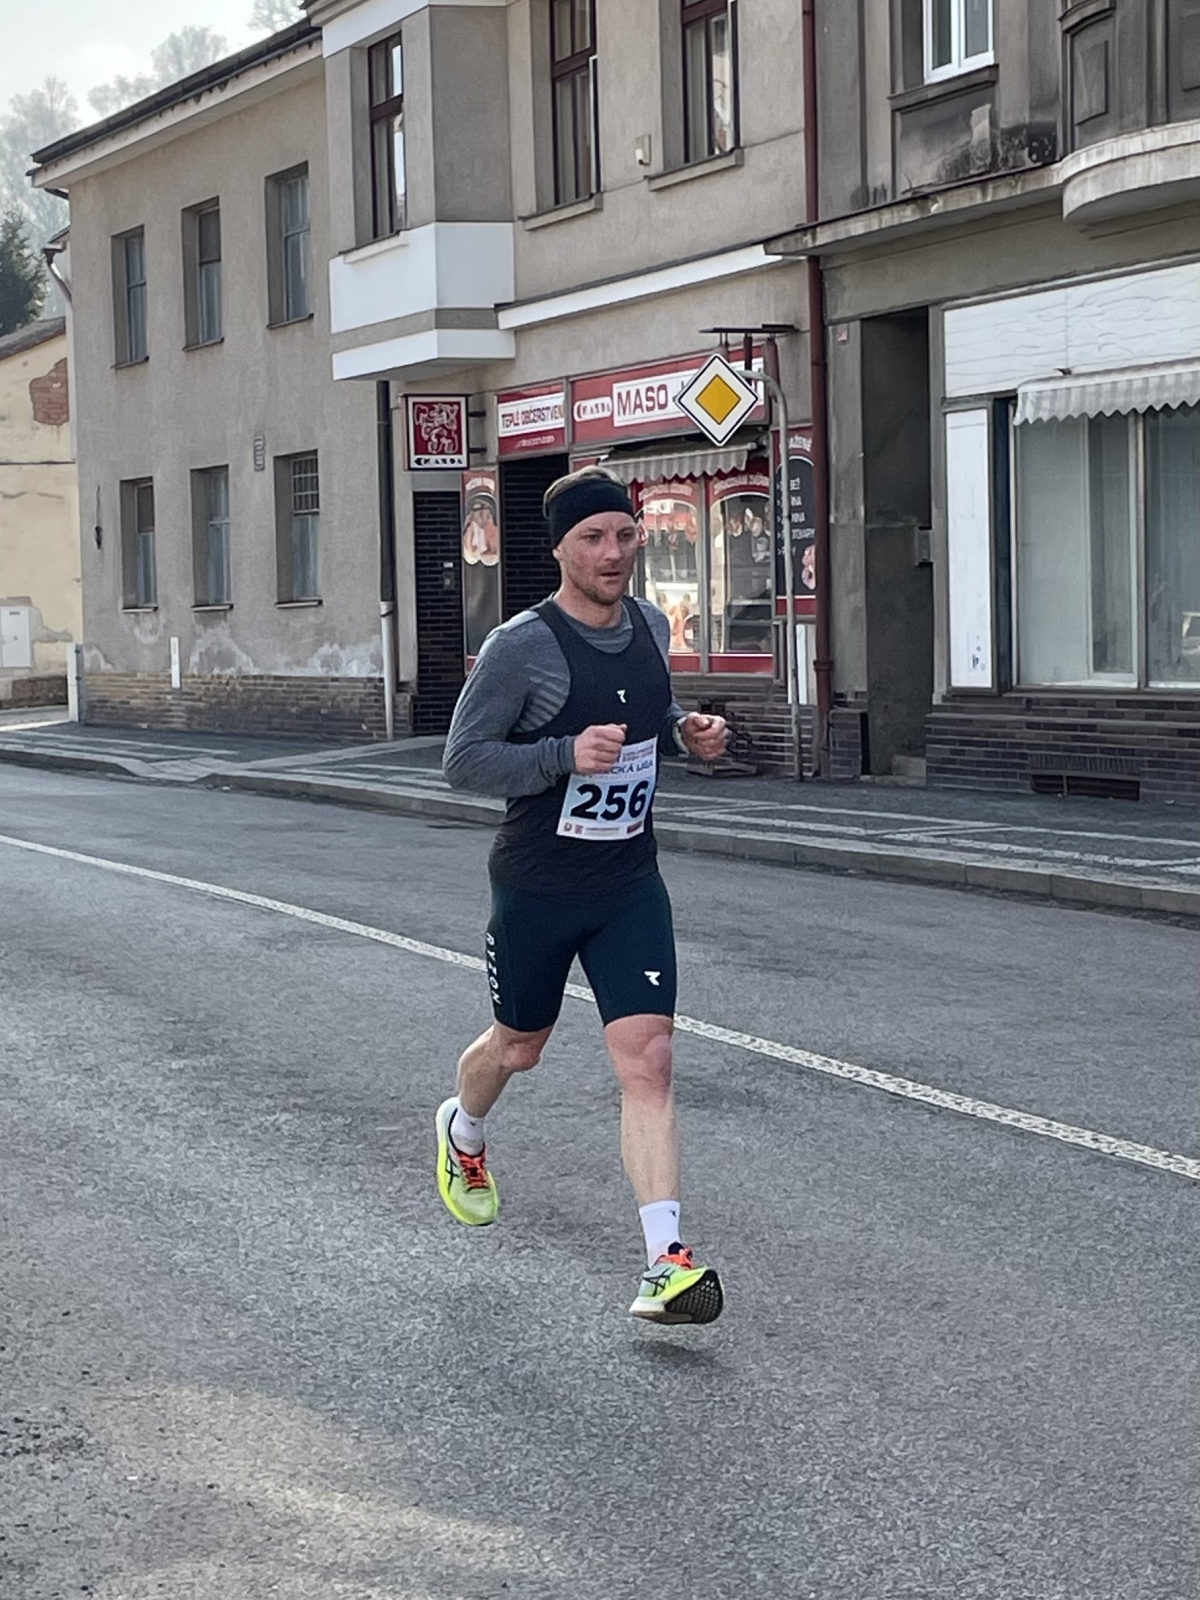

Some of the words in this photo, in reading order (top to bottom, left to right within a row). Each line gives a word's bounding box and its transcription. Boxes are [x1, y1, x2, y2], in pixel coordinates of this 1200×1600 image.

[521, 405, 564, 426] OBČERSTVEN
[617, 383, 668, 417] MASO
[570, 780, 650, 820] 256
